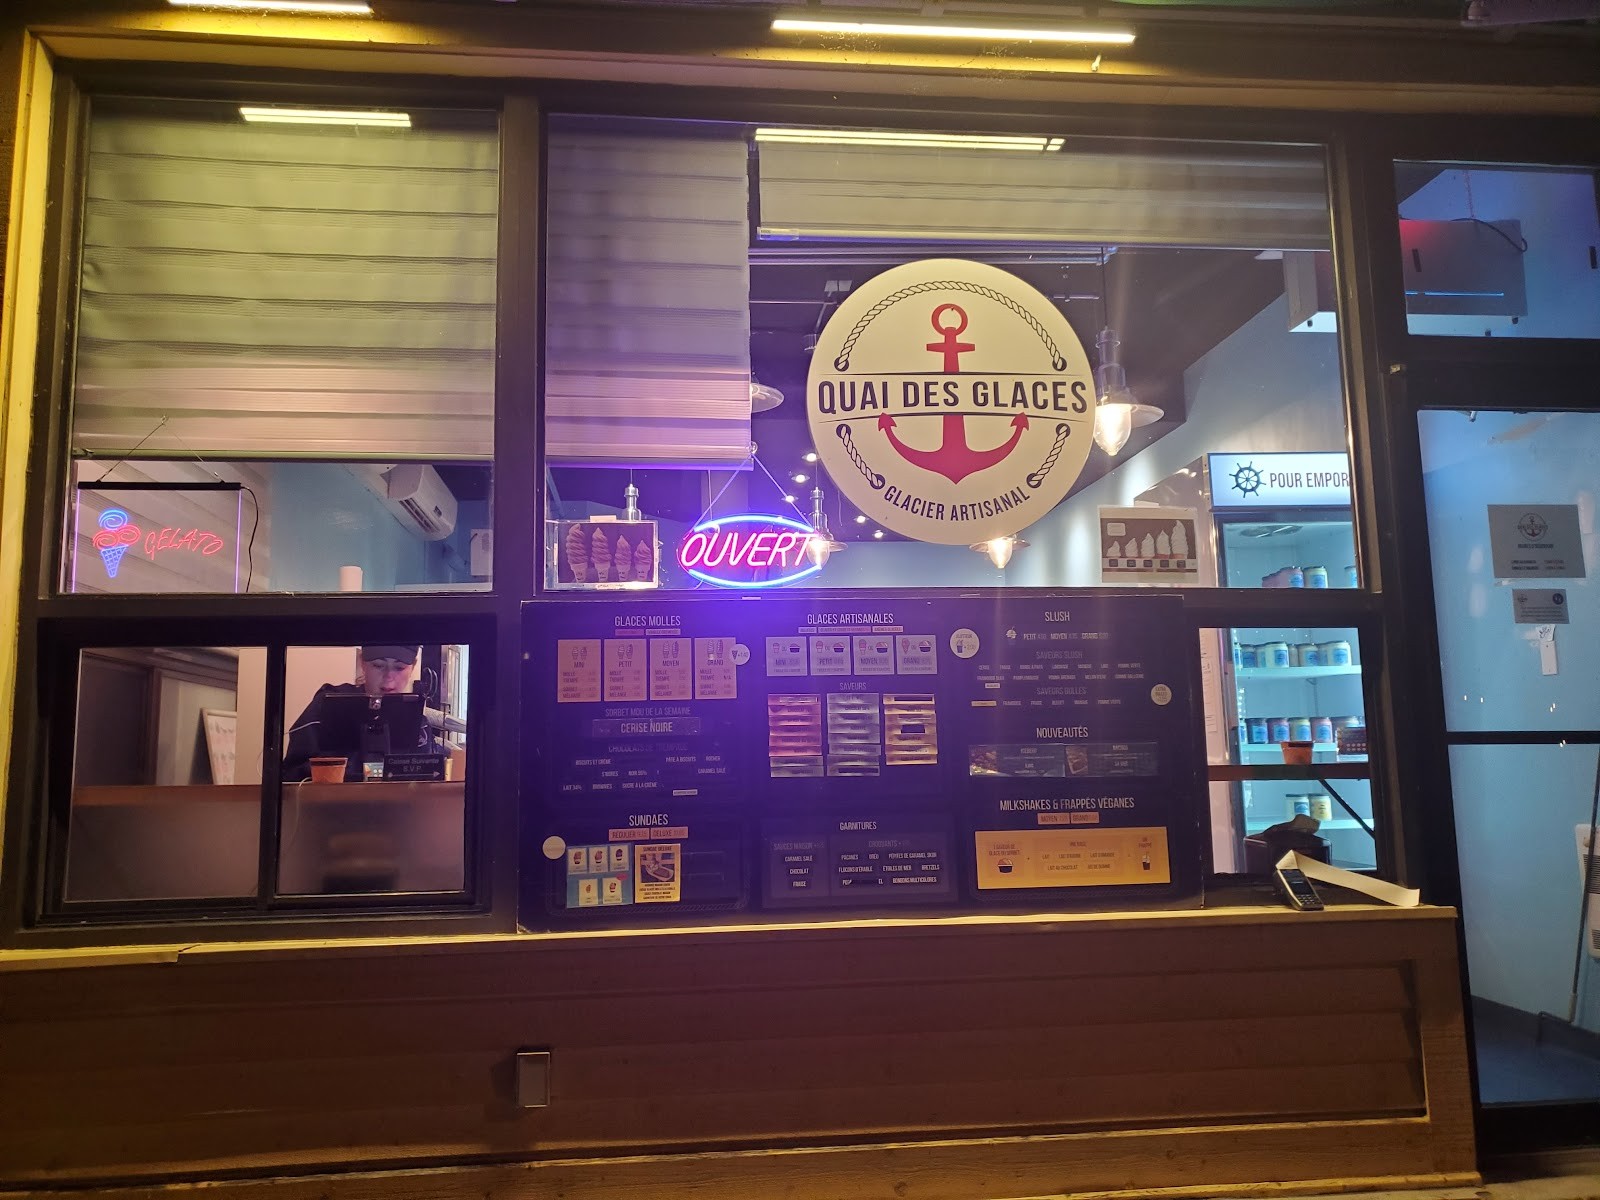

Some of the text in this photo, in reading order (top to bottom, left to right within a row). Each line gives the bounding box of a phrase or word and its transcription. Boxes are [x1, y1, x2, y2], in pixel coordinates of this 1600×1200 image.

[818, 380, 1088, 414] QUAI DES GLACES
[1269, 471, 1302, 488] POUR
[884, 485, 1030, 521] GLACIER ARTISANAL
[143, 527, 224, 561] GELATO
[680, 531, 819, 568] OUVERT
[614, 615, 681, 627] GLACES MOLLES
[807, 613, 894, 625] GLACES ARTISANALES
[1044, 611, 1070, 622] SLUSH
[840, 683, 867, 691] SAVEURS
[605, 709, 629, 717] SORBET
[664, 707, 691, 715] SEMAINE
[621, 722, 673, 733] CERISE NOIRE
[1036, 727, 1089, 738] NOUVEAUTÉS
[1000, 797, 1135, 811] MILKSHAKES & FRAPPÉS VÉGANES
[628, 813, 669, 826] SUNDAES
[839, 822, 877, 831] GARNITURES
